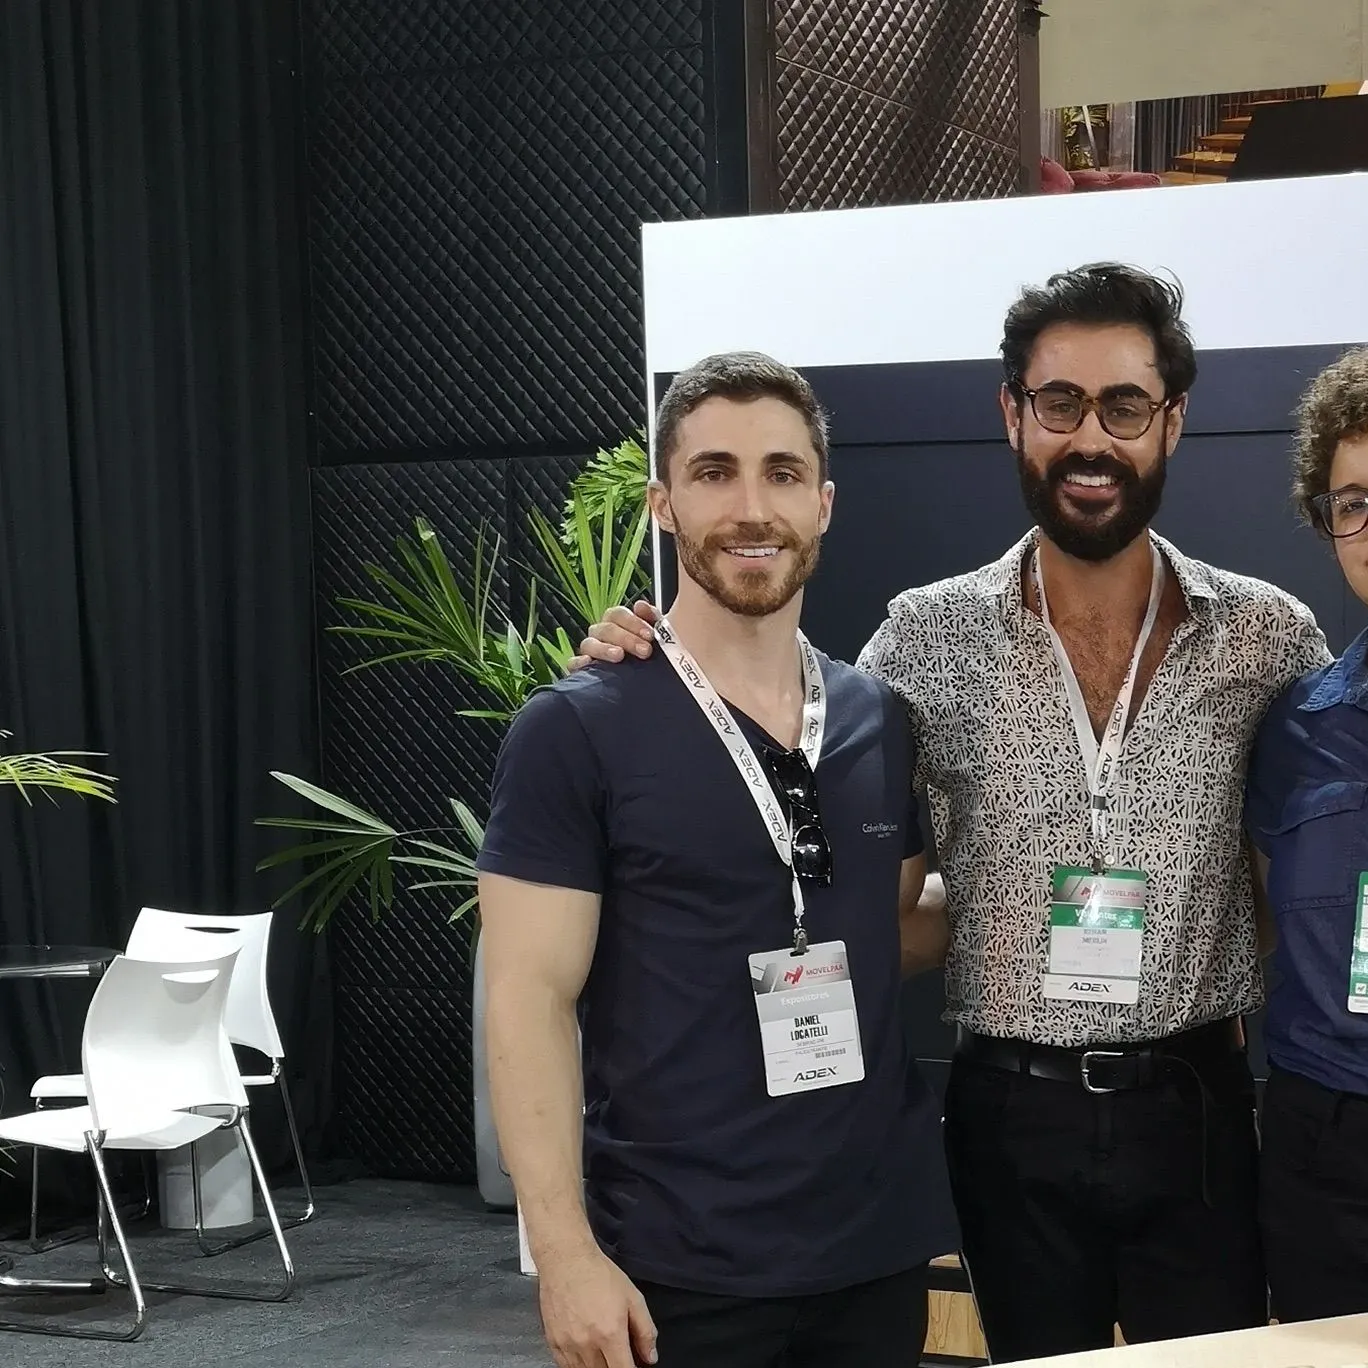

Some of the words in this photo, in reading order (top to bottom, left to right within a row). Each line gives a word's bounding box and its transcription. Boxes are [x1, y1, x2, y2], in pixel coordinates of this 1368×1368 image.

[675, 653, 705, 689] ADEX
[706, 698, 735, 736] ADEX
[1109, 701, 1124, 742] ADEX
[735, 746, 763, 788] ADEX
[762, 800, 787, 842] ADEX
[806, 964, 844, 976] MOVELPAR
[1068, 982, 1112, 993] ADEX
[790, 1026, 829, 1041] LOCATELLI
[794, 1015, 821, 1028] DANIEL
[793, 1066, 838, 1083] ADEX
